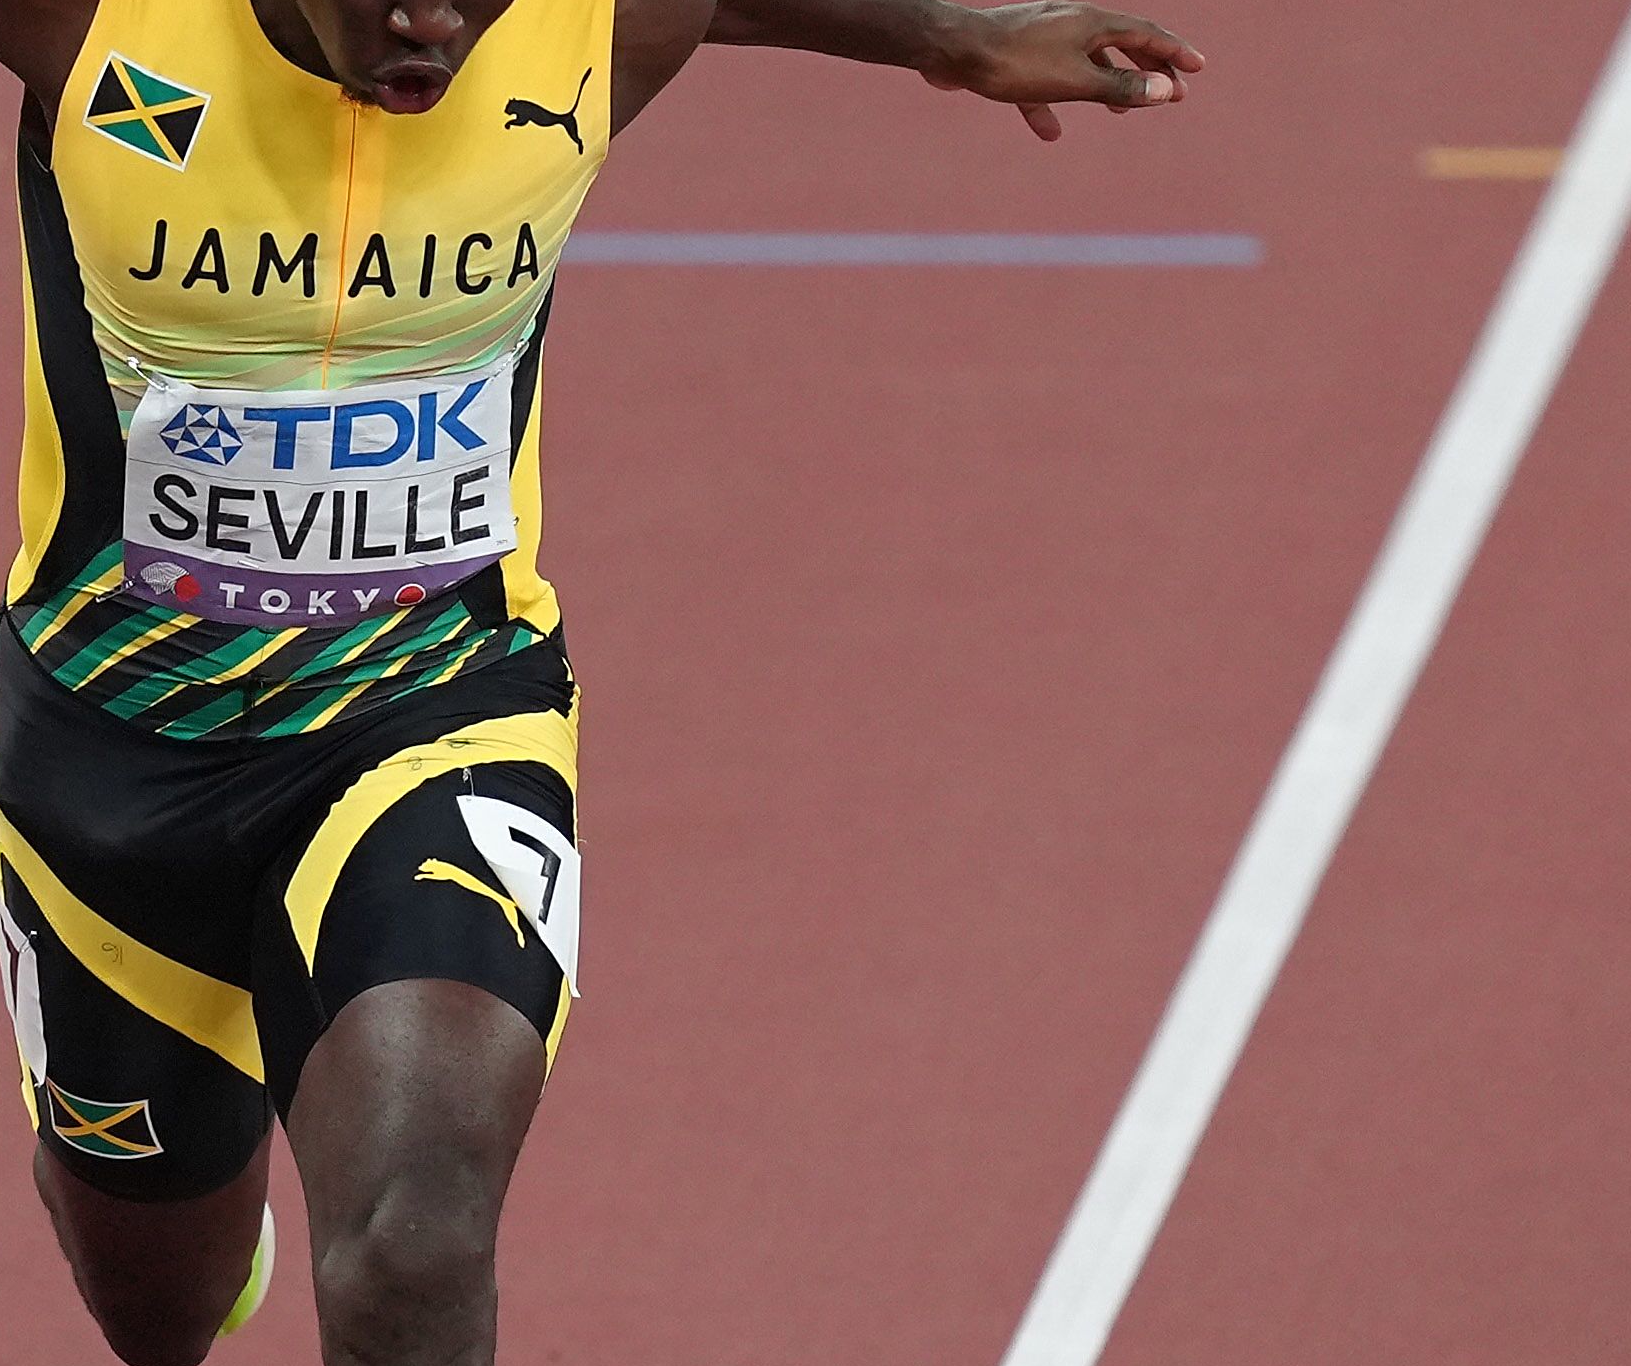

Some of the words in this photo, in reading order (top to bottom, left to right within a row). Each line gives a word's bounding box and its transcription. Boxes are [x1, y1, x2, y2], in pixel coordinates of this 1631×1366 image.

[127, 218, 541, 300] JAMAICA
[243, 377, 489, 471] TDK
[147, 464, 492, 562] SEVILLE
[218, 580, 457, 616] TOKYO
[507, 825, 562, 925] 7
